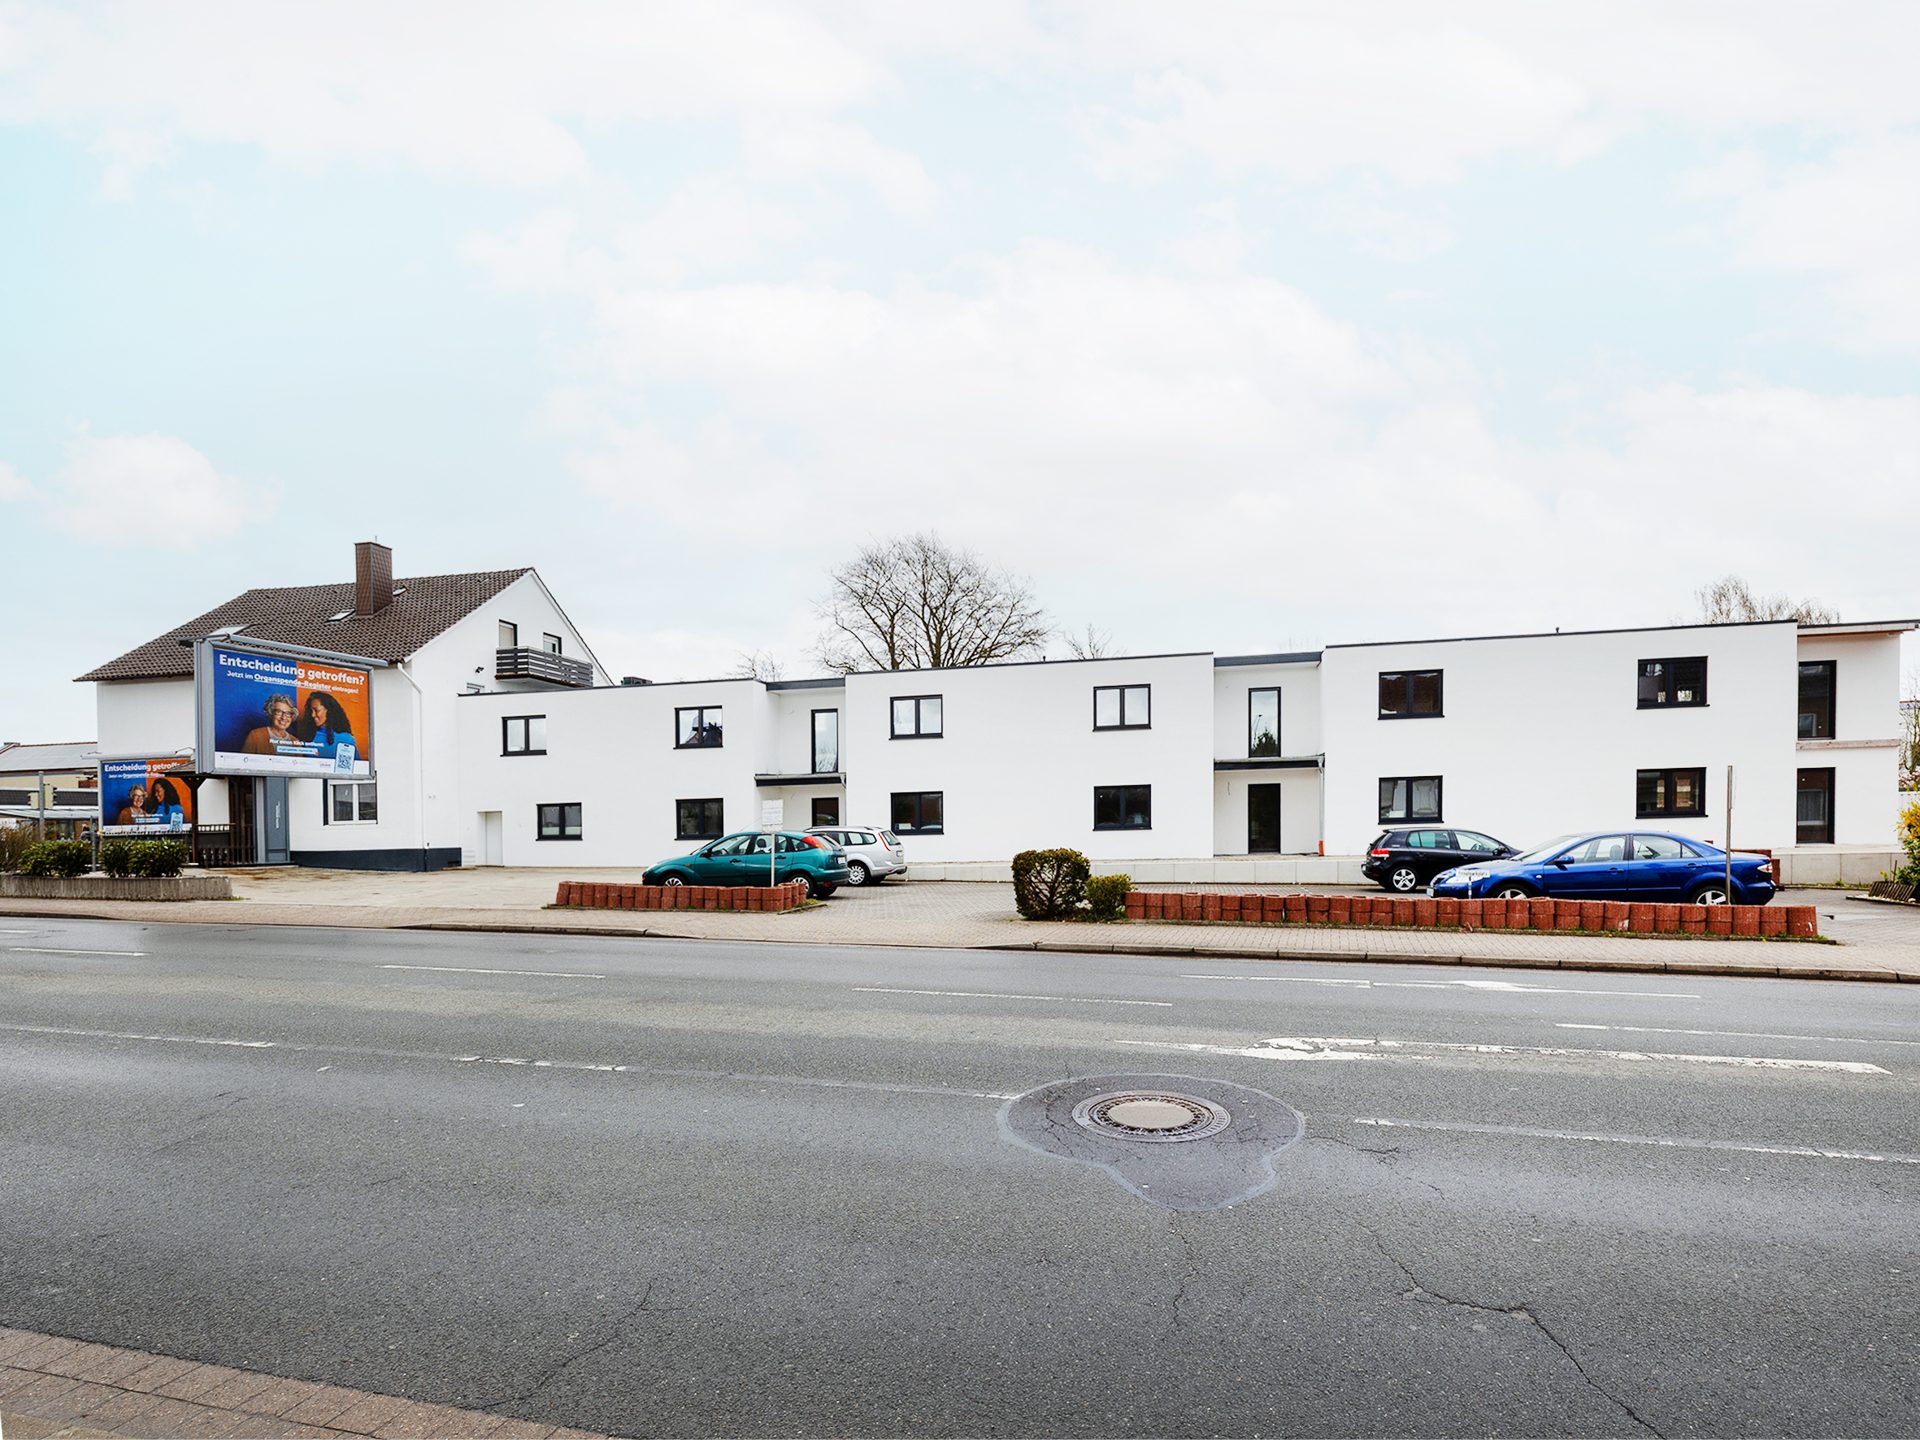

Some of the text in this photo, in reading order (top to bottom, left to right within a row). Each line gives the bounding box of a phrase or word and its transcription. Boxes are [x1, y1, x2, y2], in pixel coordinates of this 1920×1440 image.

[219, 654, 365, 685] Entscheidung getroffen?
[227, 670, 244, 679] Jetzt
[254, 673, 331, 691] Organspende-Register
[104, 763, 152, 772] Entscheidung
